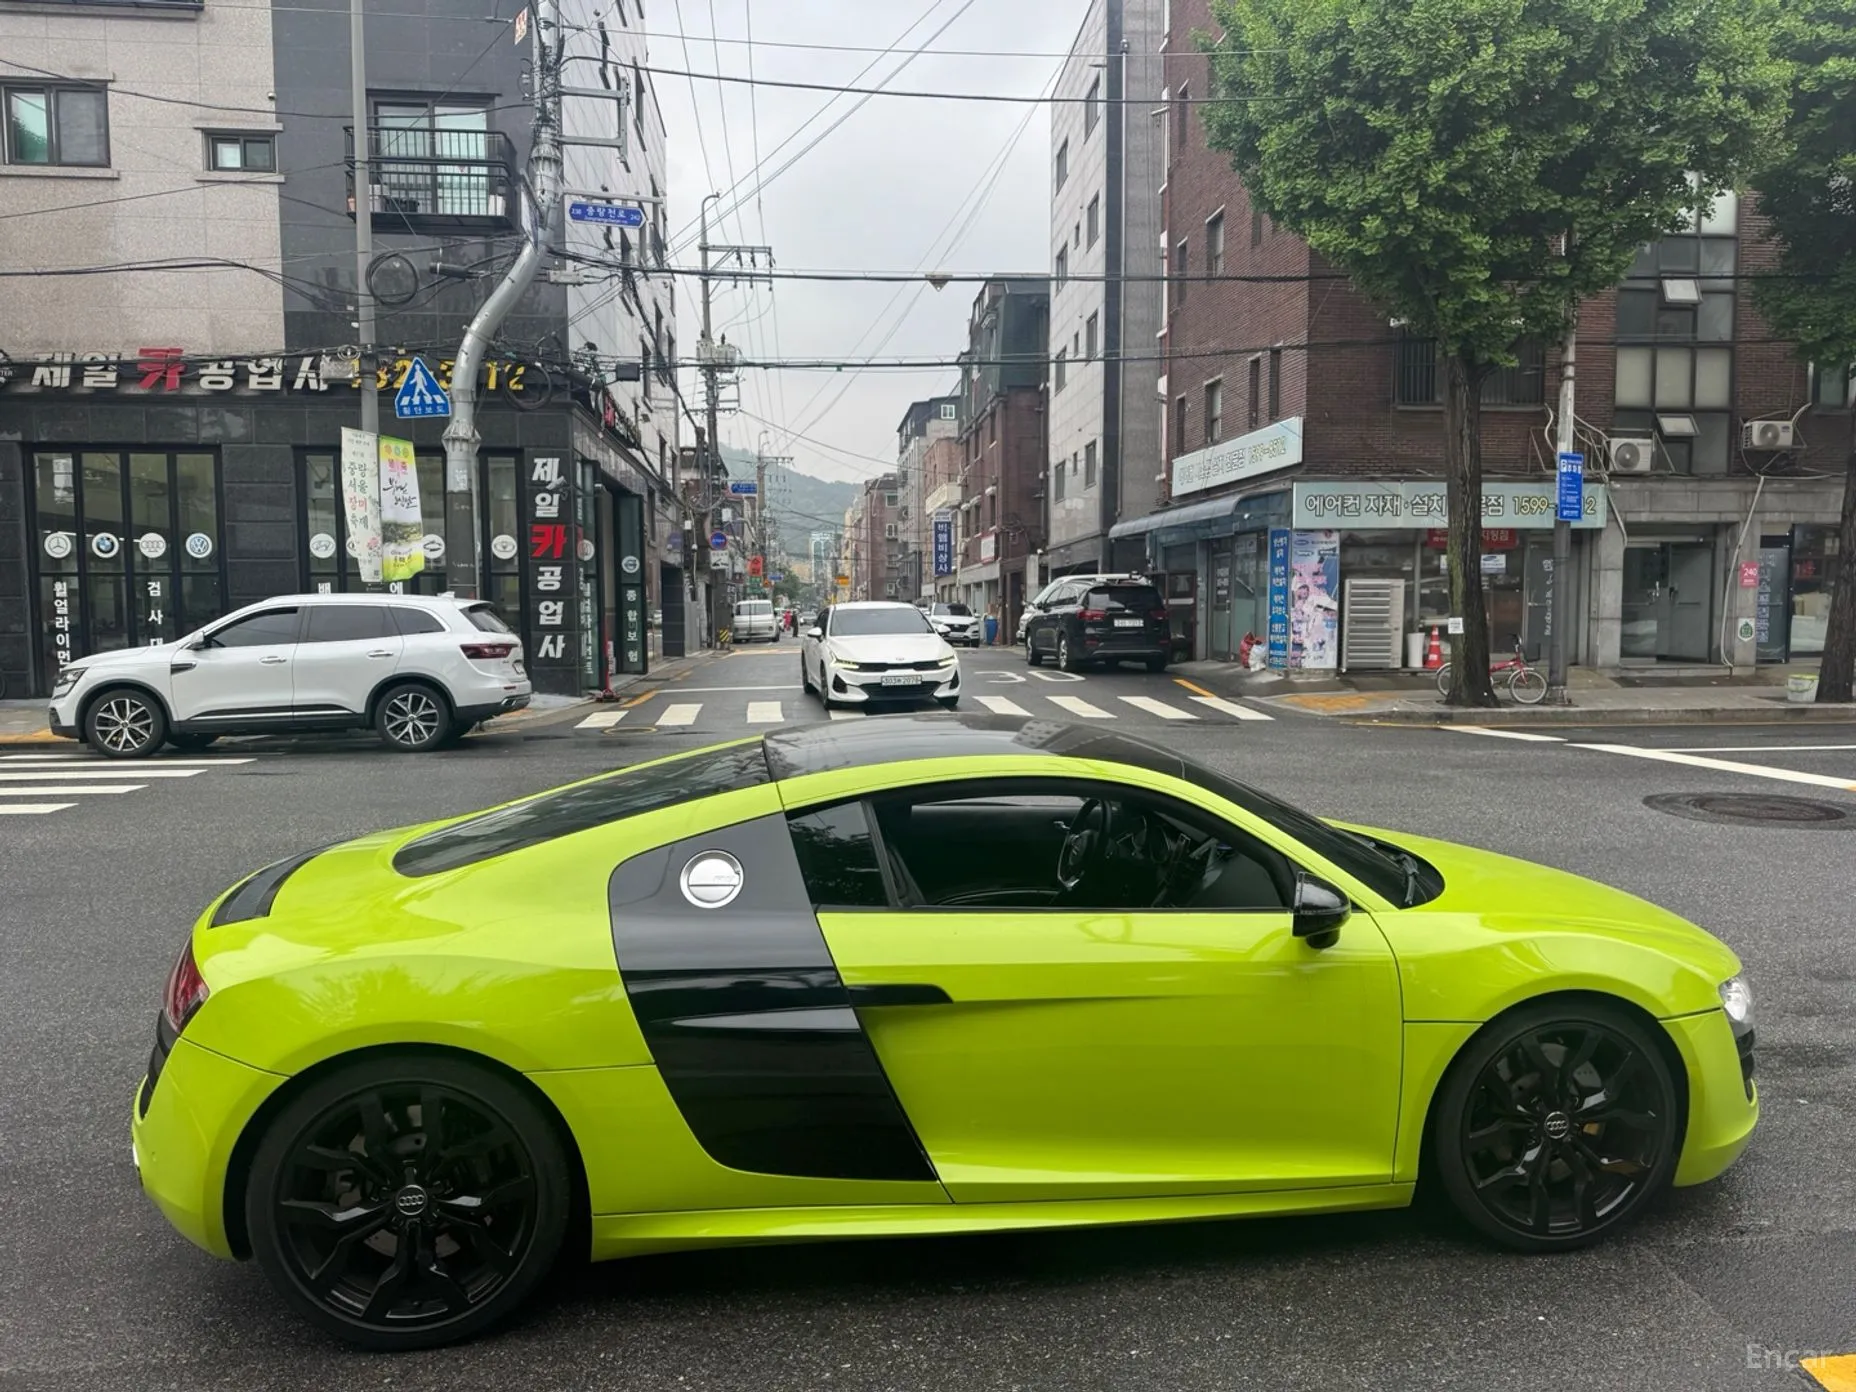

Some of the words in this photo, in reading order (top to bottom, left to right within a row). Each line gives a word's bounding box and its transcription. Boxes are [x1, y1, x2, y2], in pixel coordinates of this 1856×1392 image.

[586, 206, 626, 218] 중랑천로
[31, 347, 330, 392] 제일카공업사
[402, 403, 446, 415] 횡단보도
[1304, 495, 1361, 518] 에어컨
[531, 457, 569, 661] 제일카공업사
